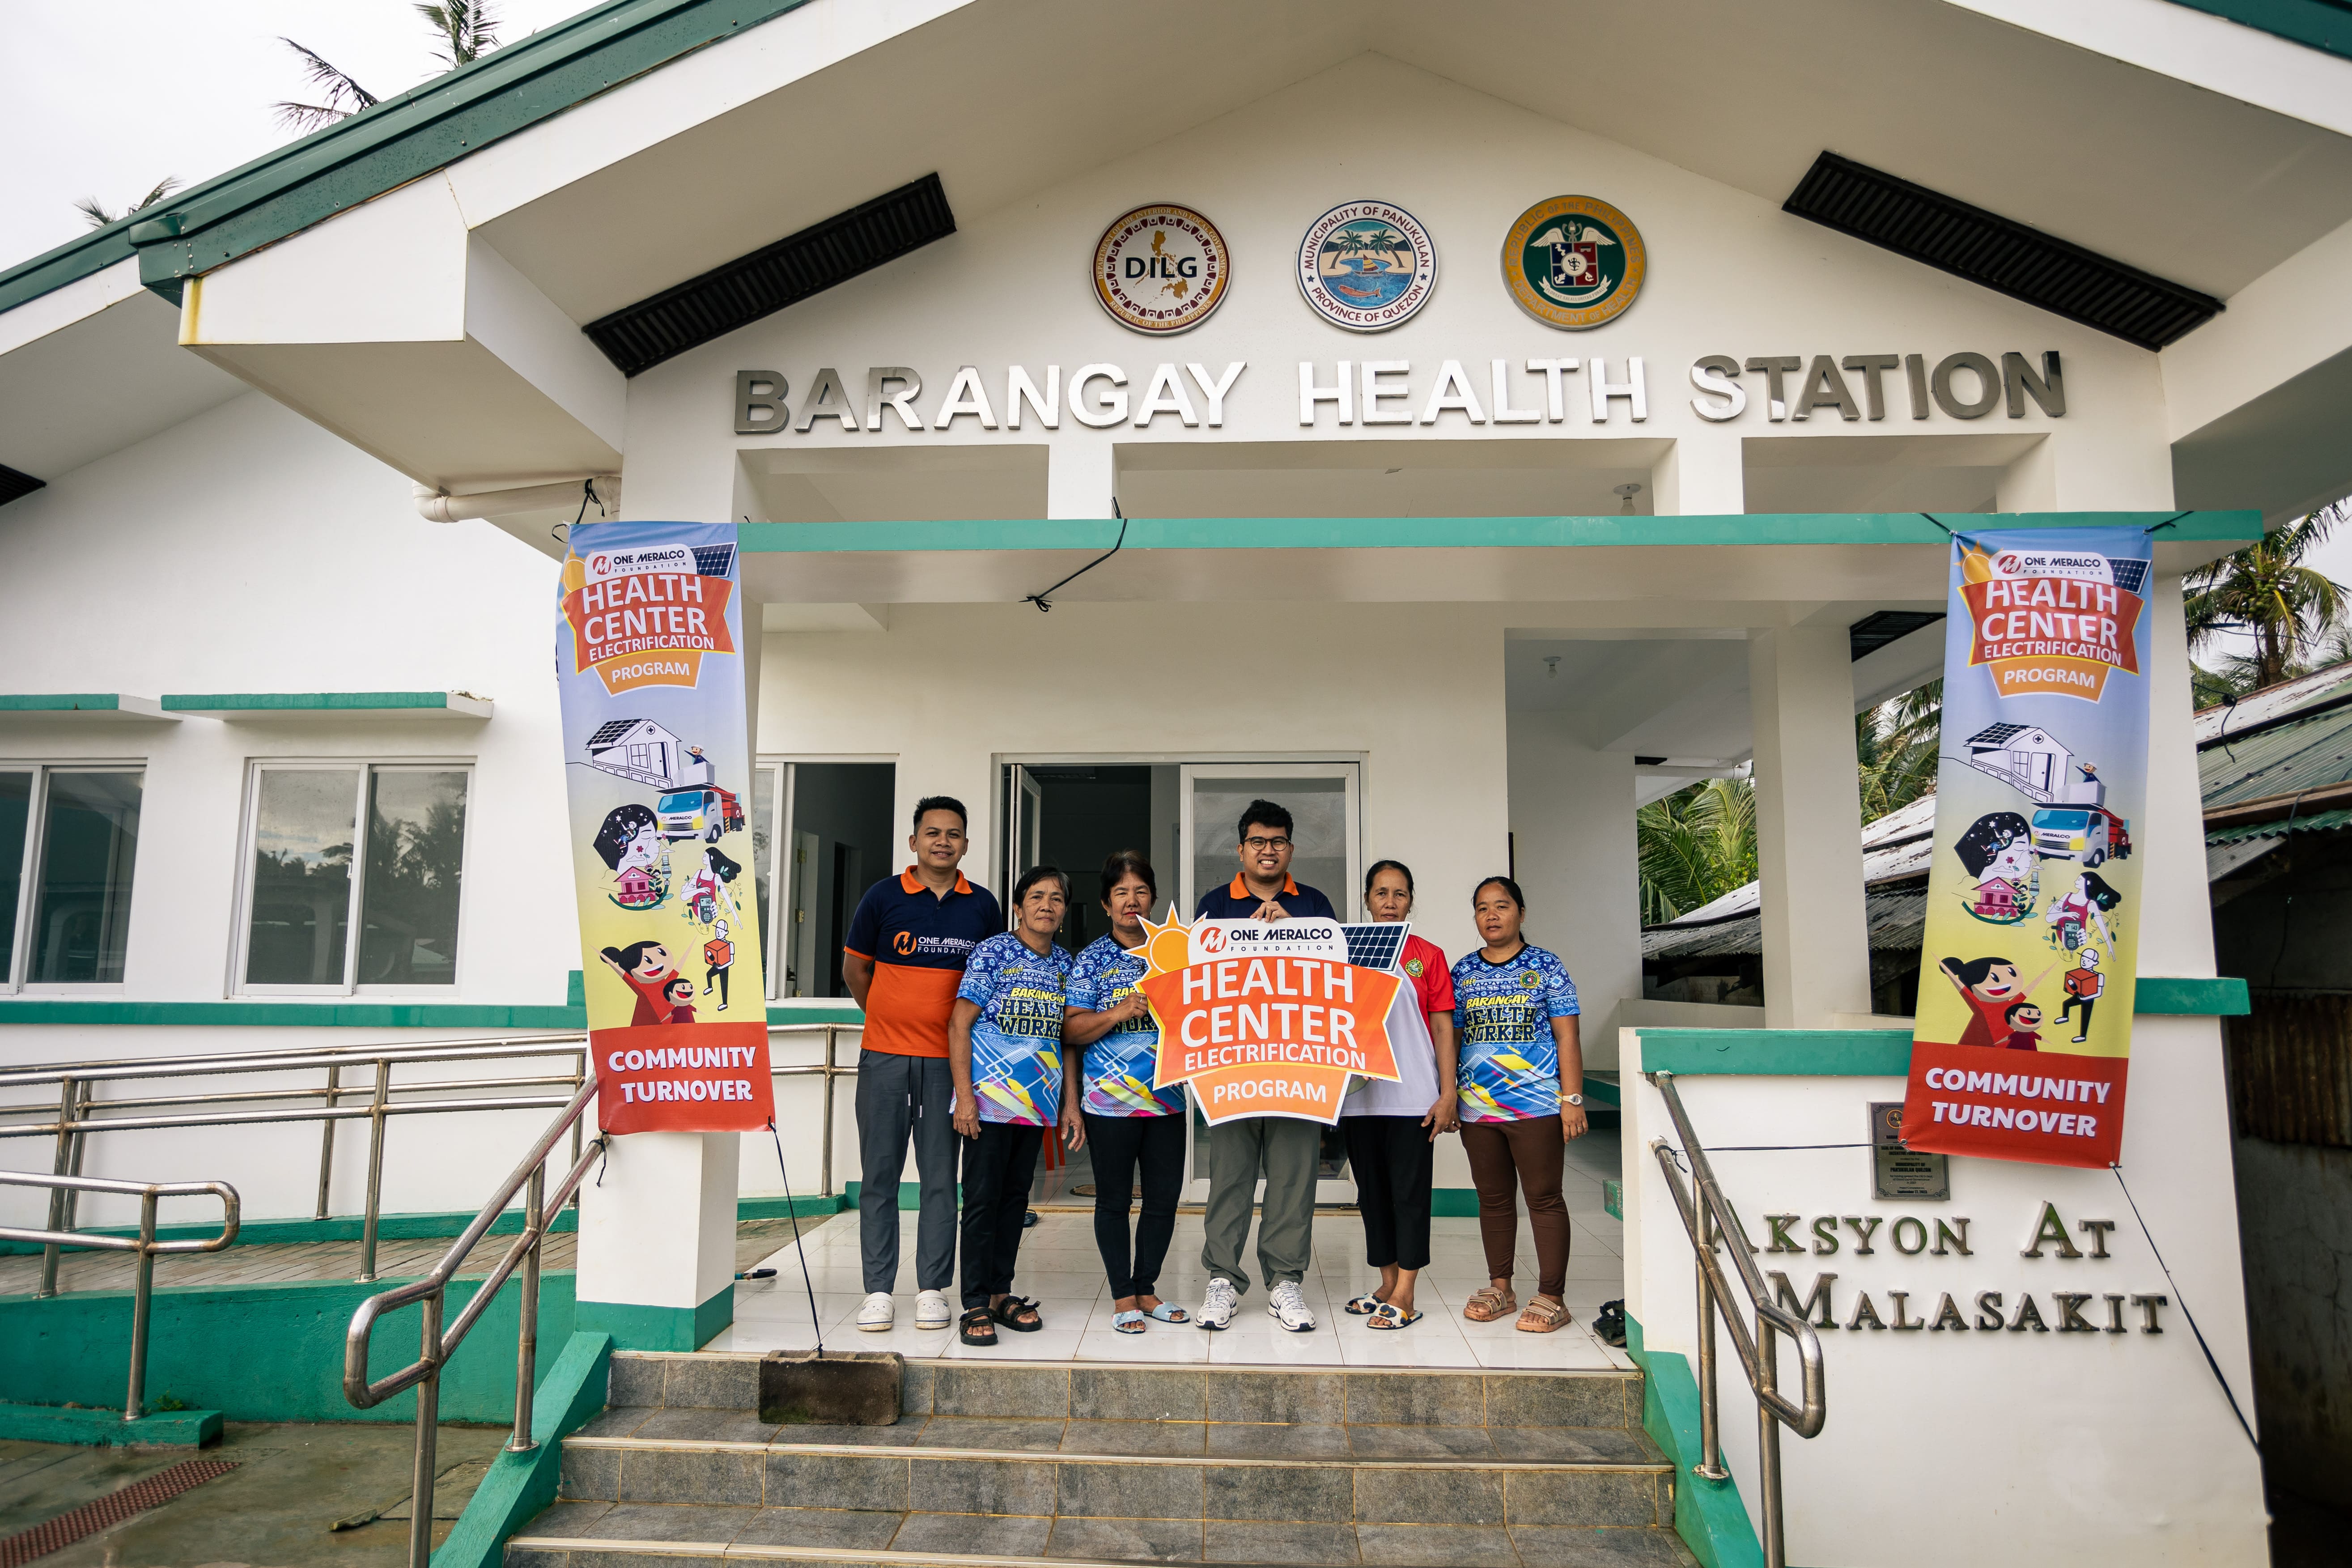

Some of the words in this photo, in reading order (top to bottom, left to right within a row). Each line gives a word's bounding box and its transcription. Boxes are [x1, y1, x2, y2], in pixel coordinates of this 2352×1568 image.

[1098, 234, 1114, 280] DEPARTMENT
[1113, 225, 1120, 234] OF
[1120, 217, 1134, 229] THE
[1135, 208, 1171, 221] INTERIOR
[1173, 209, 1188, 218] AND
[1188, 214, 1209, 233] LOCAL
[1208, 231, 1226, 279] GOVERNMENT
[1304, 207, 1358, 269] MUNICIPALITY
[1363, 206, 1379, 215] OF
[1381, 209, 1430, 268] PANUKULAN
[1508, 209, 1544, 267] REPUBLIC
[1548, 204, 1559, 213] OF
[1562, 202, 1580, 210] THE
[1584, 202, 1641, 263] PHILIPPINES
[1125, 257, 1197, 278] DILG
[1312, 287, 1361, 322] PROVINCE
[1364, 312, 1380, 322] OF
[1382, 285, 1424, 319] QUEZON
[1514, 280, 1585, 322] DEPARTMENT
[1589, 310, 1600, 320] OF
[1603, 276, 1638, 315] HEALTH
[1109, 301, 1142, 325] REPUBLIC
[1171, 300, 1212, 327] PHILIPPINES
[734, 362, 1247, 434] BARANGAY
[1298, 357, 1647, 426] HEALTH
[1689, 351, 2066, 422] STATION
[614, 554, 633, 565] ONE
[637, 550, 685, 562] MERALCO
[615, 562, 686, 573] FOUNDATION
[2025, 557, 2046, 566] ONE
[2050, 557, 2101, 567] MERALCO
[582, 574, 703, 614] HEALTH
[1986, 580, 2117, 616] HEALTH
[584, 606, 709, 645] CENTER
[1982, 611, 2118, 650] CENTER
[589, 635, 715, 662] ELECTRIFICATION
[1984, 641, 2121, 666] ELECTRIFICATION
[611, 662, 690, 683] PROGRAM
[2004, 668, 2094, 688] PROGRAM
[941, 938, 975, 948] MERALCO
[1231, 930, 1259, 940] ONE
[1263, 928, 1332, 940] MERALCO
[918, 947, 969, 955] FOUNDATIO
[1183, 959, 1353, 1005] HEALTH
[999, 998, 1064, 1021] HEALT
[1466, 995, 1530, 1009] BARANGAY
[997, 1016, 1062, 1040] WORKE
[1181, 1003, 1357, 1048] CENTER
[1465, 1006, 1537, 1028] HEALTH
[1465, 1024, 1536, 1045] WORKER
[608, 1046, 756, 1072] COMMUNITY
[1185, 1043, 1366, 1072] ELECTRIFICATION
[621, 1080, 753, 1103] TURNOVER
[1214, 1080, 1327, 1104] PROGRAM
[1925, 1067, 2110, 1104] COMMUNITY
[1932, 1101, 2096, 1138] TURNOVER
[2020, 1200, 2115, 1258] AT
[1765, 1270, 2168, 1334] MALASAKIT
